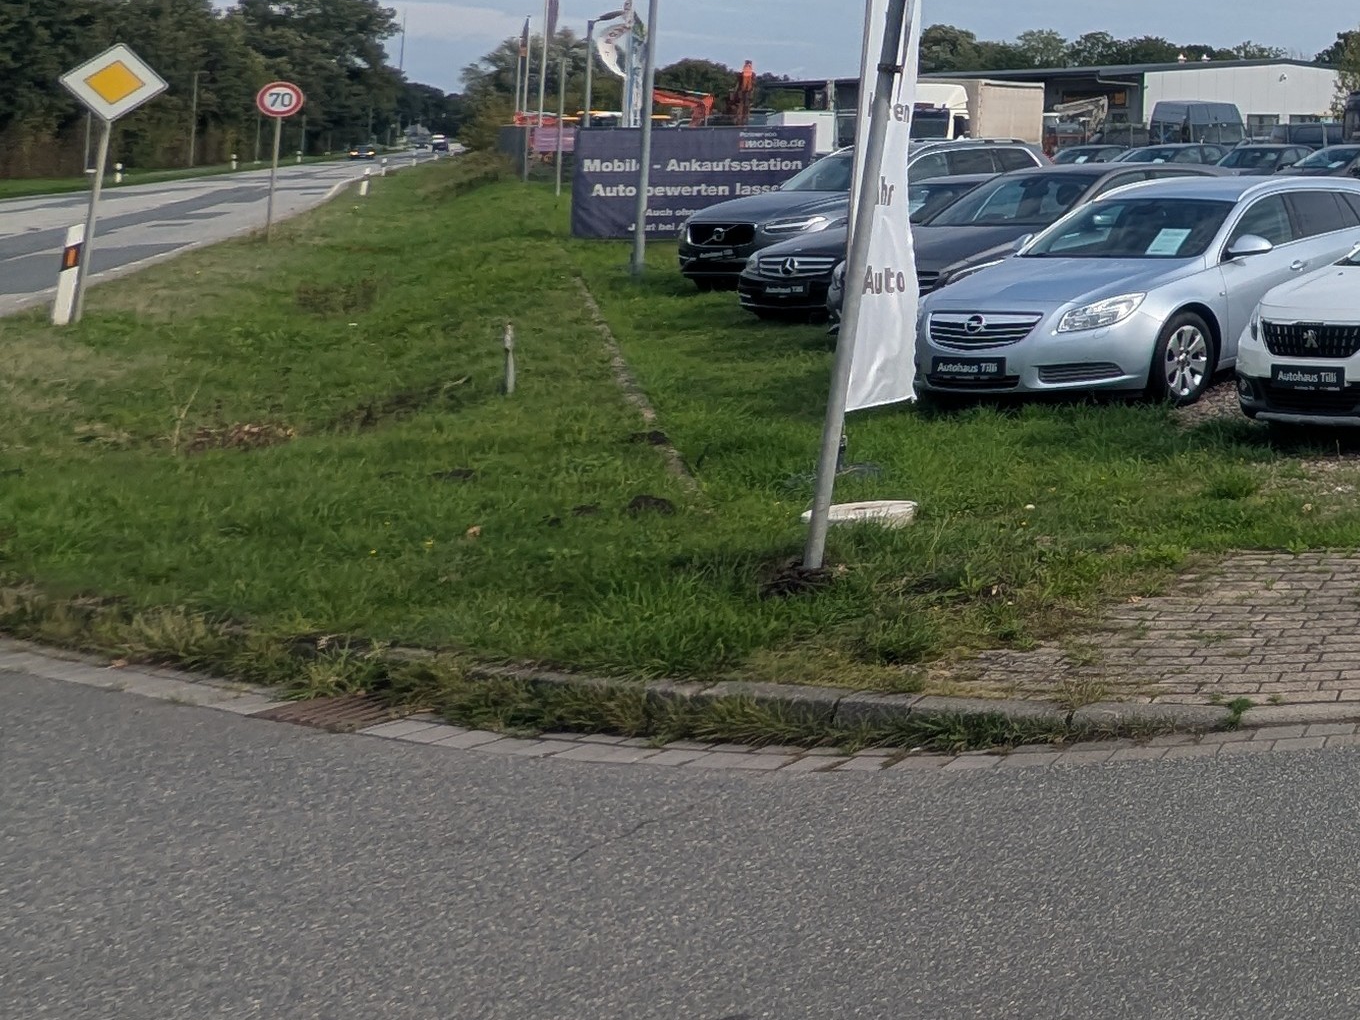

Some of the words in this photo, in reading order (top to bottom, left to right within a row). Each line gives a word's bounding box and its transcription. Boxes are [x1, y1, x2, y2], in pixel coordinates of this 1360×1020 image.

[269, 92, 293, 108] 70
[742, 138, 806, 148] mobile.de
[665, 157, 803, 172] Ankaufsstation
[591, 184, 637, 197] Auto
[862, 265, 906, 296] Auto
[937, 362, 979, 373] Autohaus
[980, 362, 998, 373] Tilli
[1277, 370, 1319, 383] Autohaus
[1320, 371, 1337, 383] Tilli
